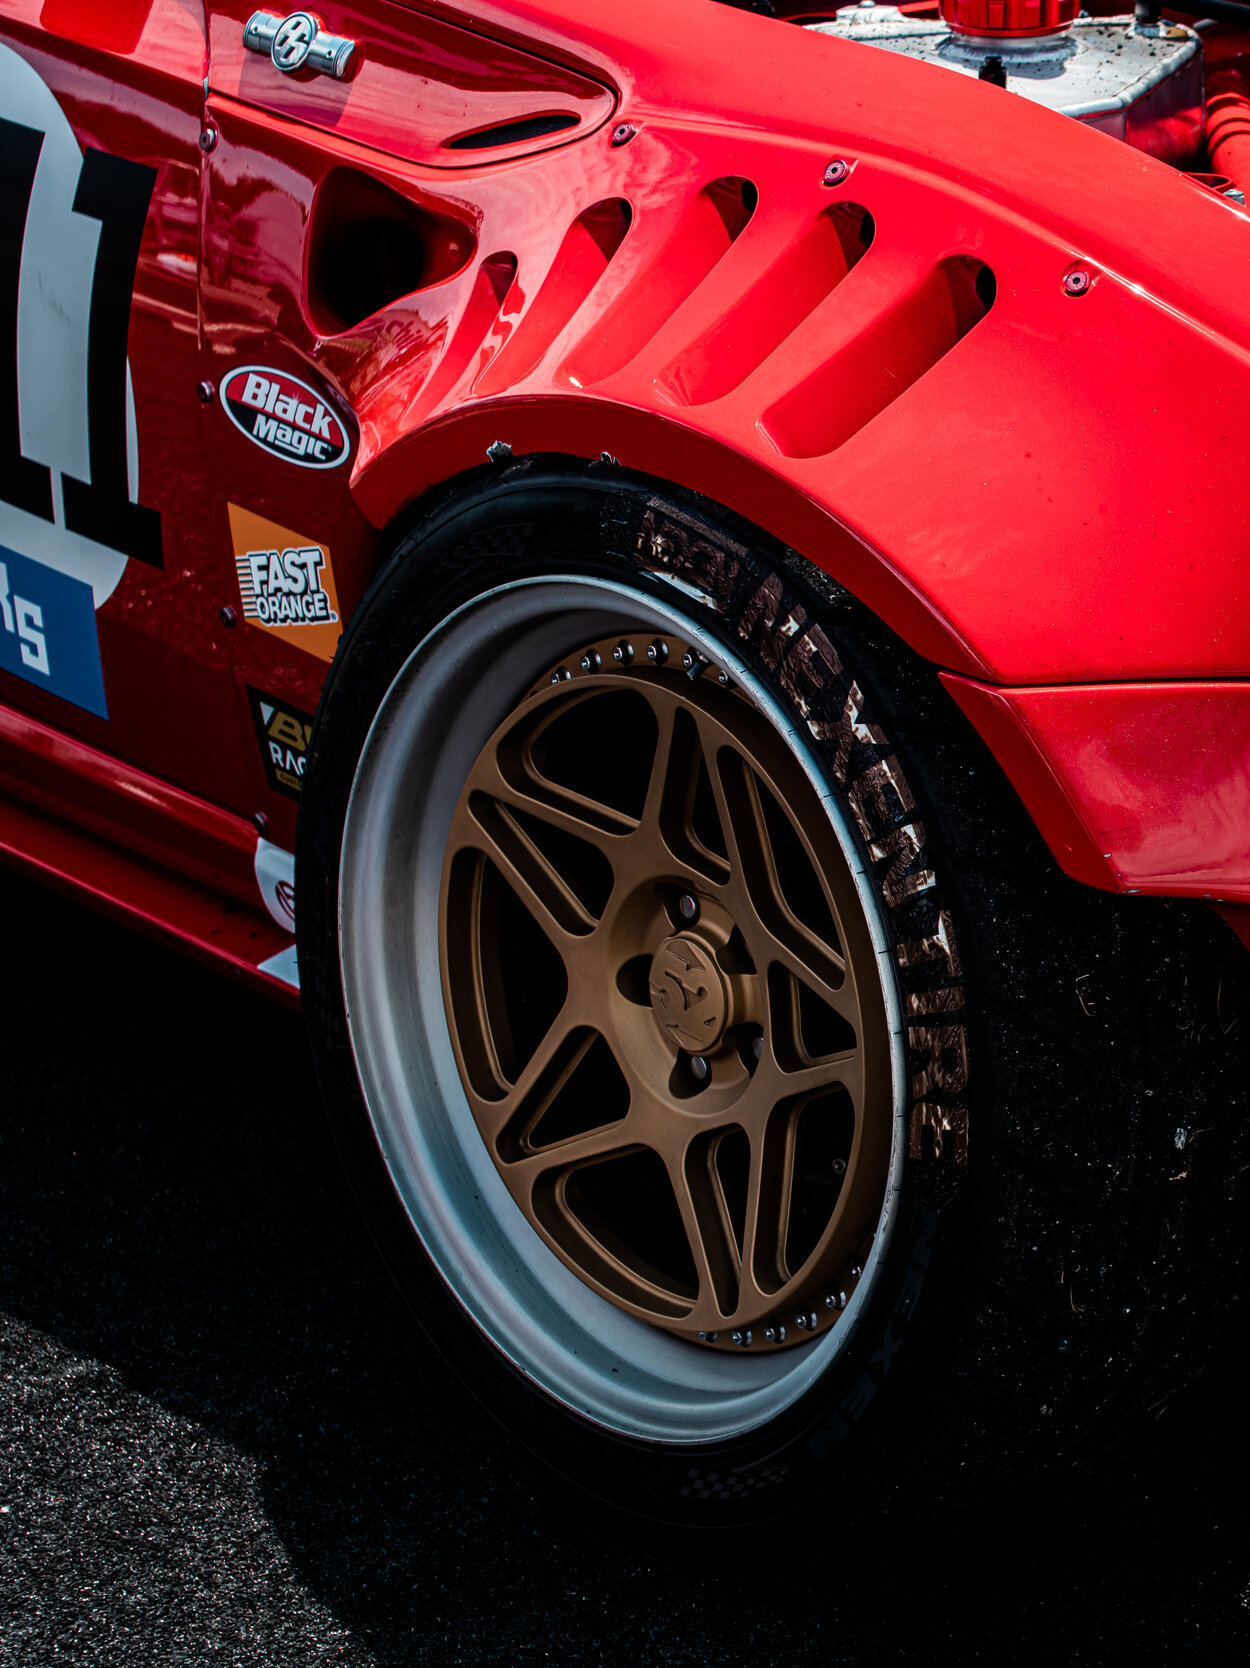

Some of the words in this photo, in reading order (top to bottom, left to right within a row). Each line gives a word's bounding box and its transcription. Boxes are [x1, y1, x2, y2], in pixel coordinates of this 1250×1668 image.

[241, 372, 333, 440] Black
[252, 413, 328, 461] Magic
[248, 549, 323, 595] FAST
[256, 592, 330, 622] ORANGE
[735, 571, 939, 909] NEXEN
[896, 908, 972, 1168] TIRE
